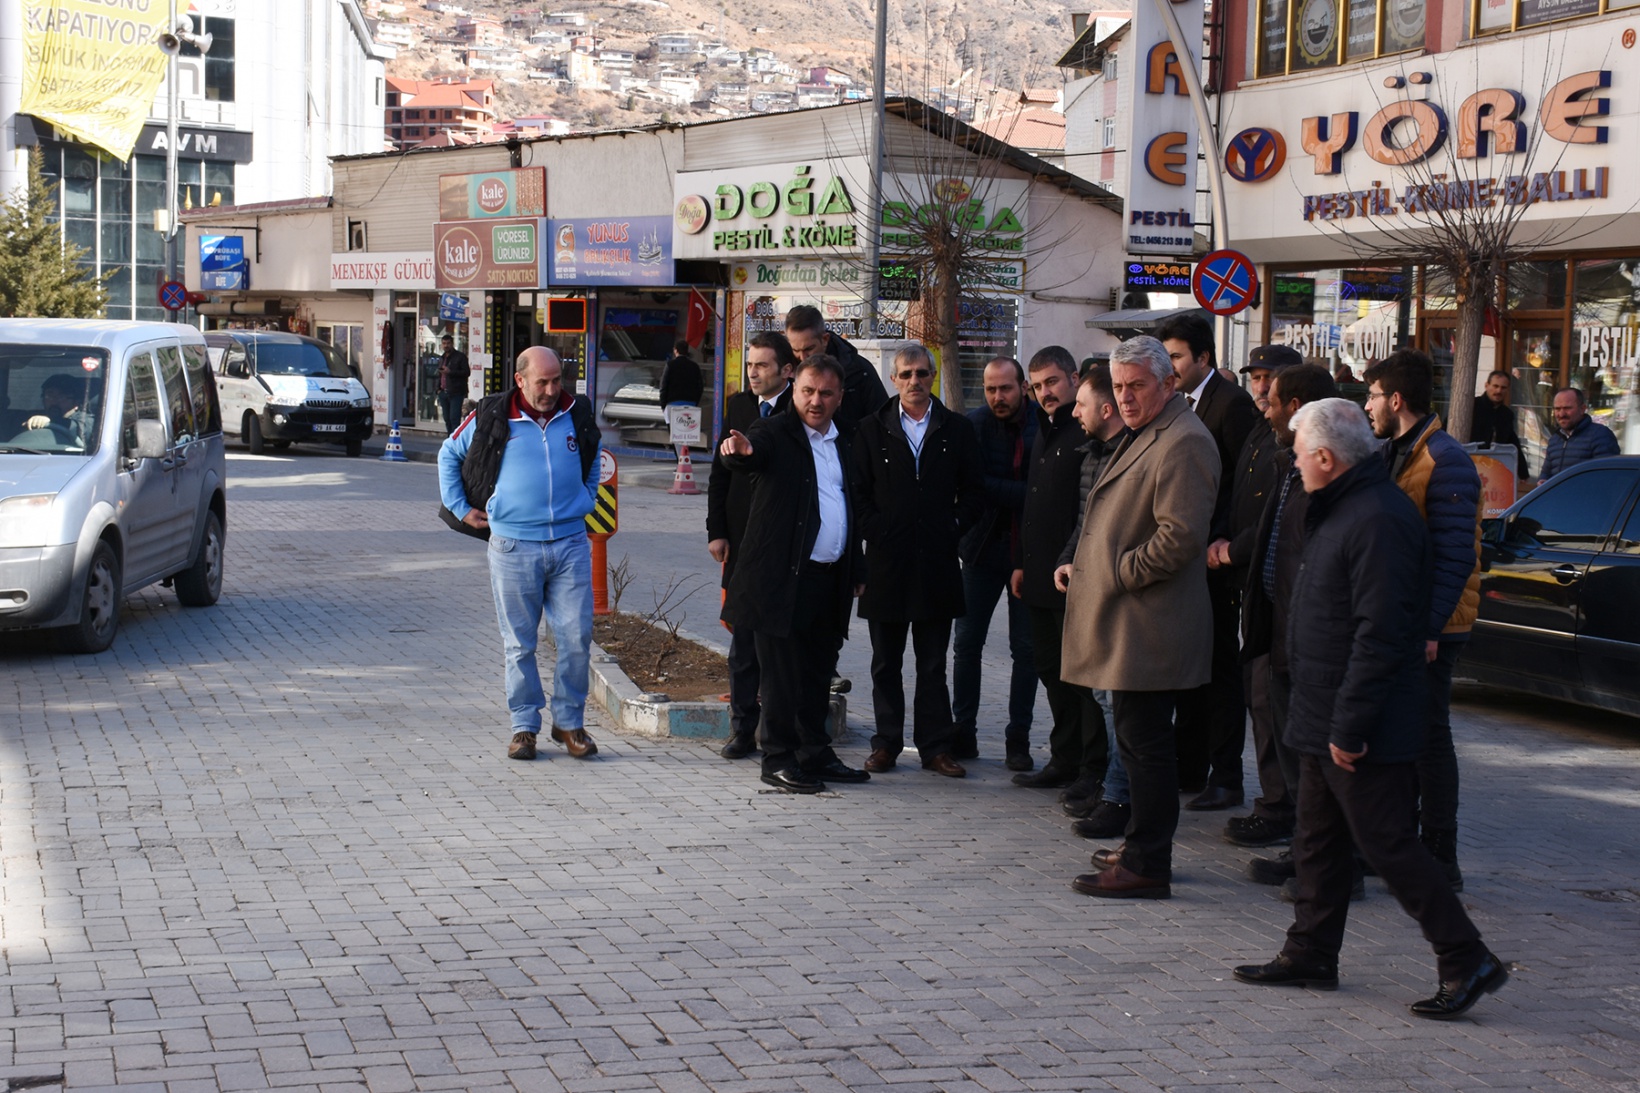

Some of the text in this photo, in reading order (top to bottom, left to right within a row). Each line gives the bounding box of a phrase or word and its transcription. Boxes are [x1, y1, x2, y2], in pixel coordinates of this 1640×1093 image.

[1301, 70, 1612, 175] YÖRE
[151, 131, 217, 154] AVM
[481, 184, 504, 200] kale
[714, 166, 857, 220] DOĞA
[1130, 208, 1195, 227] PESTİL
[497, 229, 529, 243] YÖRESEL
[587, 221, 630, 245] YUNUS
[713, 220, 857, 250] PESTİL & KÖME
[1130, 235, 1145, 244] TEL:
[444, 239, 477, 264] kale
[497, 246, 530, 260] ÜRÜNLER
[584, 248, 632, 267] BALIKÇILIK
[332, 258, 435, 285] MENEKŞE GÜMÜ
[487, 269, 536, 285] SATIŞ NOKTASI
[756, 261, 816, 286] Doğadan
[820, 261, 860, 286] Gelen
[1144, 264, 1189, 275] YÖRE
[1128, 275, 1157, 285] PESTİL
[1163, 275, 1189, 286] KÖME
